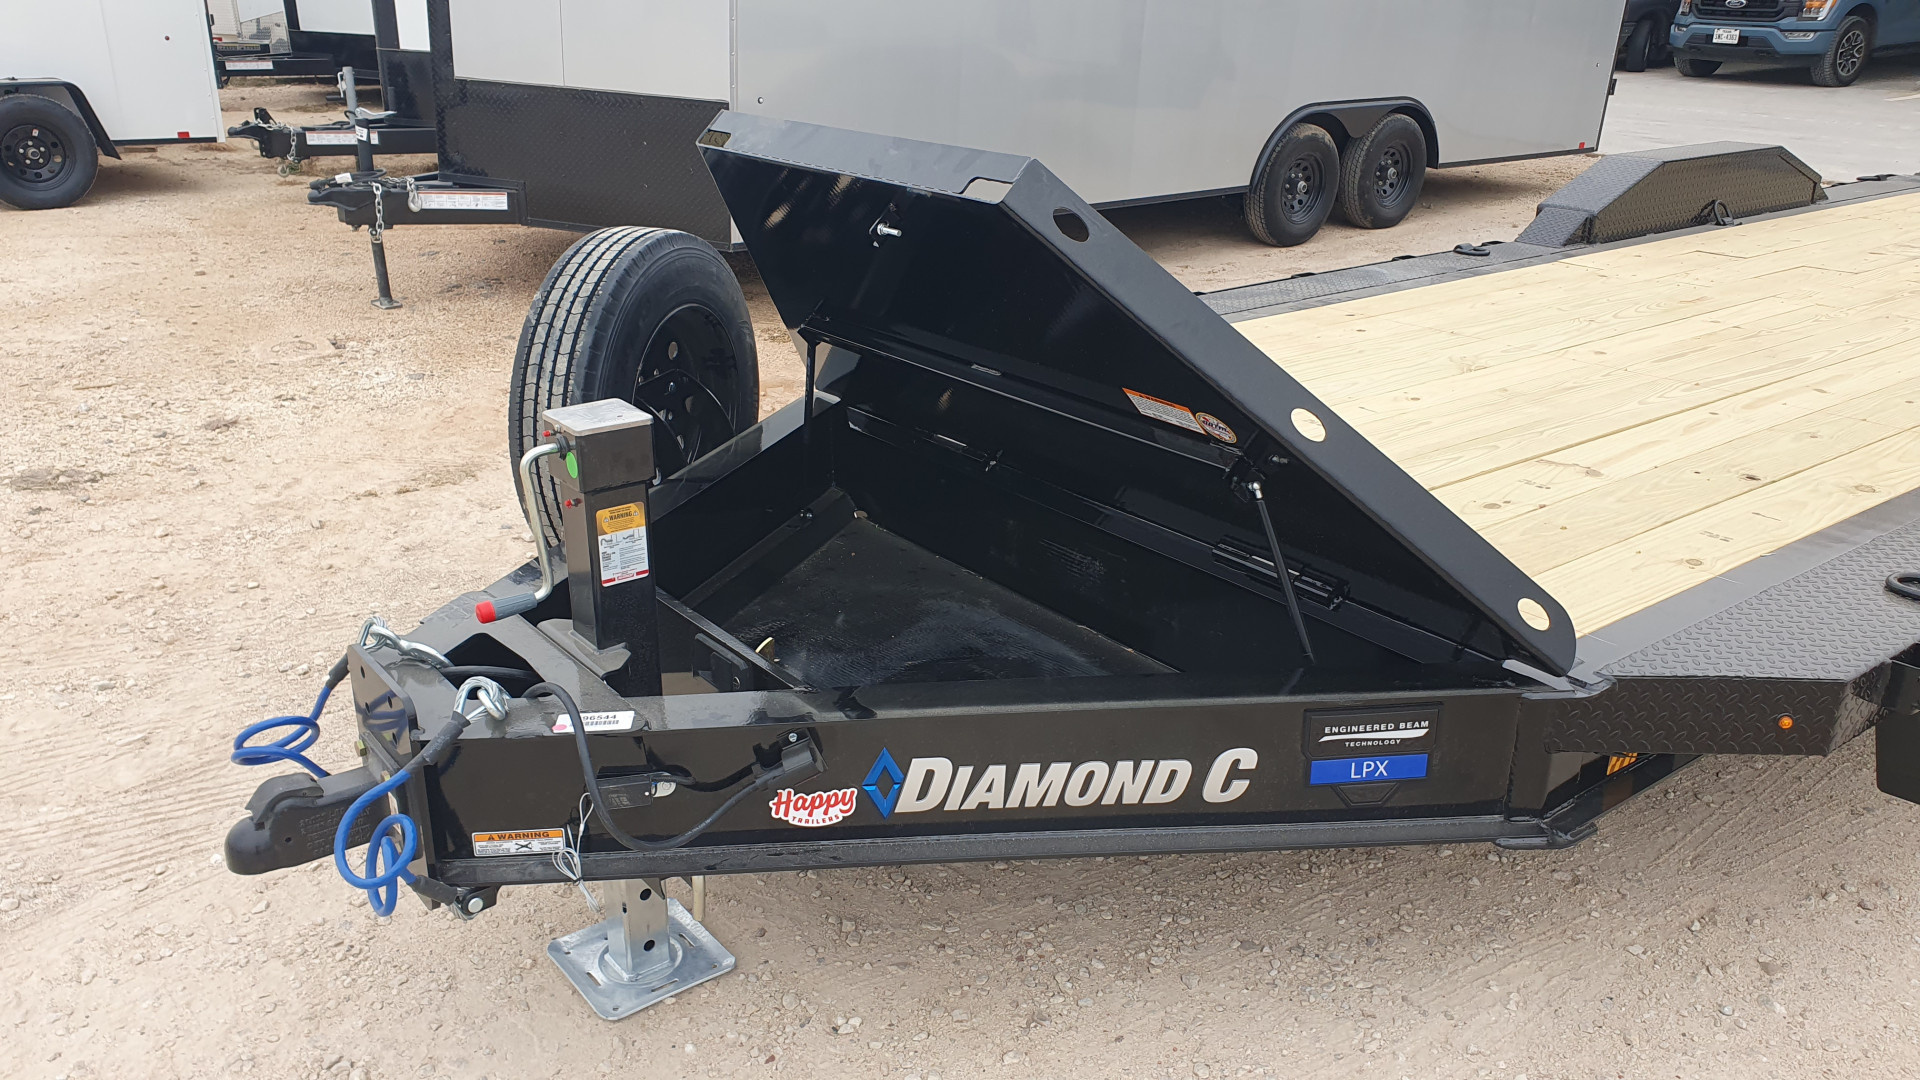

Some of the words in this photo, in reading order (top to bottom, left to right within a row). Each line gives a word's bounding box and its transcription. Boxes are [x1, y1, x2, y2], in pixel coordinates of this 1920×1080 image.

[609, 511, 633, 521] WARNING
[1324, 723, 1395, 734] ENGINEERED
[1399, 720, 1430, 730] BEAM
[1344, 739, 1402, 748] TECHNOLOGY
[1350, 760, 1389, 779] LPX
[893, 757, 1193, 815] DIAMOND
[1201, 747, 1259, 804] C
[771, 788, 857, 819] Happy
[791, 814, 841, 826] TRAILERS
[497, 831, 550, 840] WARNING
